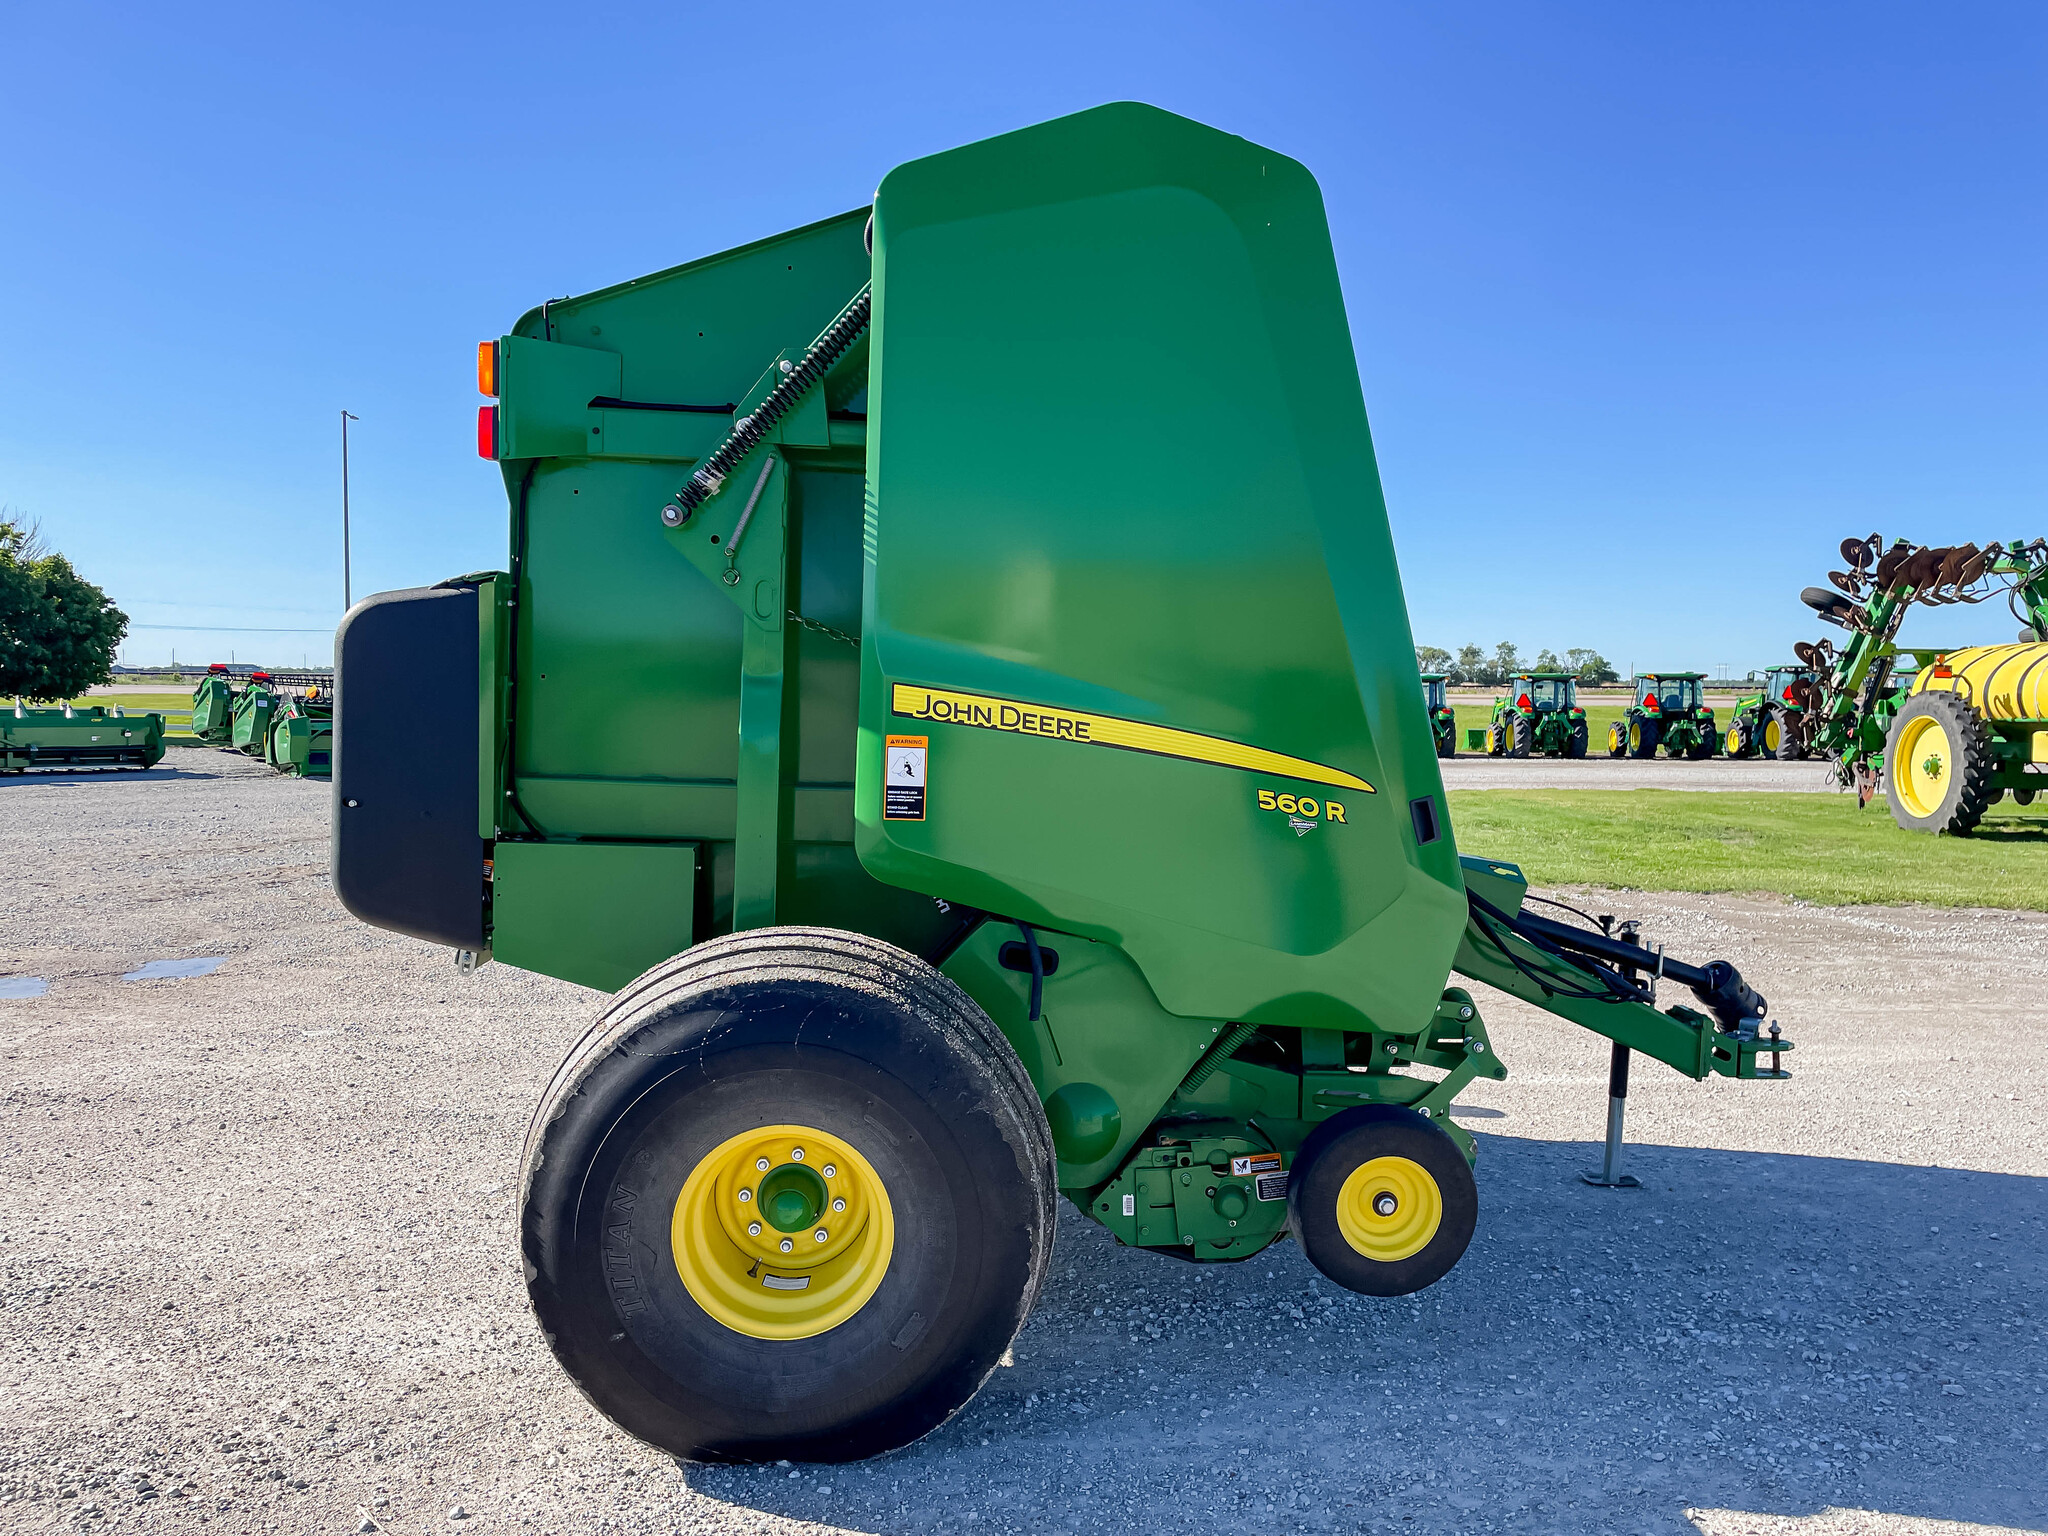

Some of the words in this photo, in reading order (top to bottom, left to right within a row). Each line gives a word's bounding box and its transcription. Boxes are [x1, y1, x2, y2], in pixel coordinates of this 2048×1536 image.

[916, 695, 992, 724] JOHN
[1000, 705, 1091, 739] DEERE
[1257, 789, 1320, 818] 560
[1325, 800, 1348, 824] R
[606, 1183, 648, 1320] TITAN
